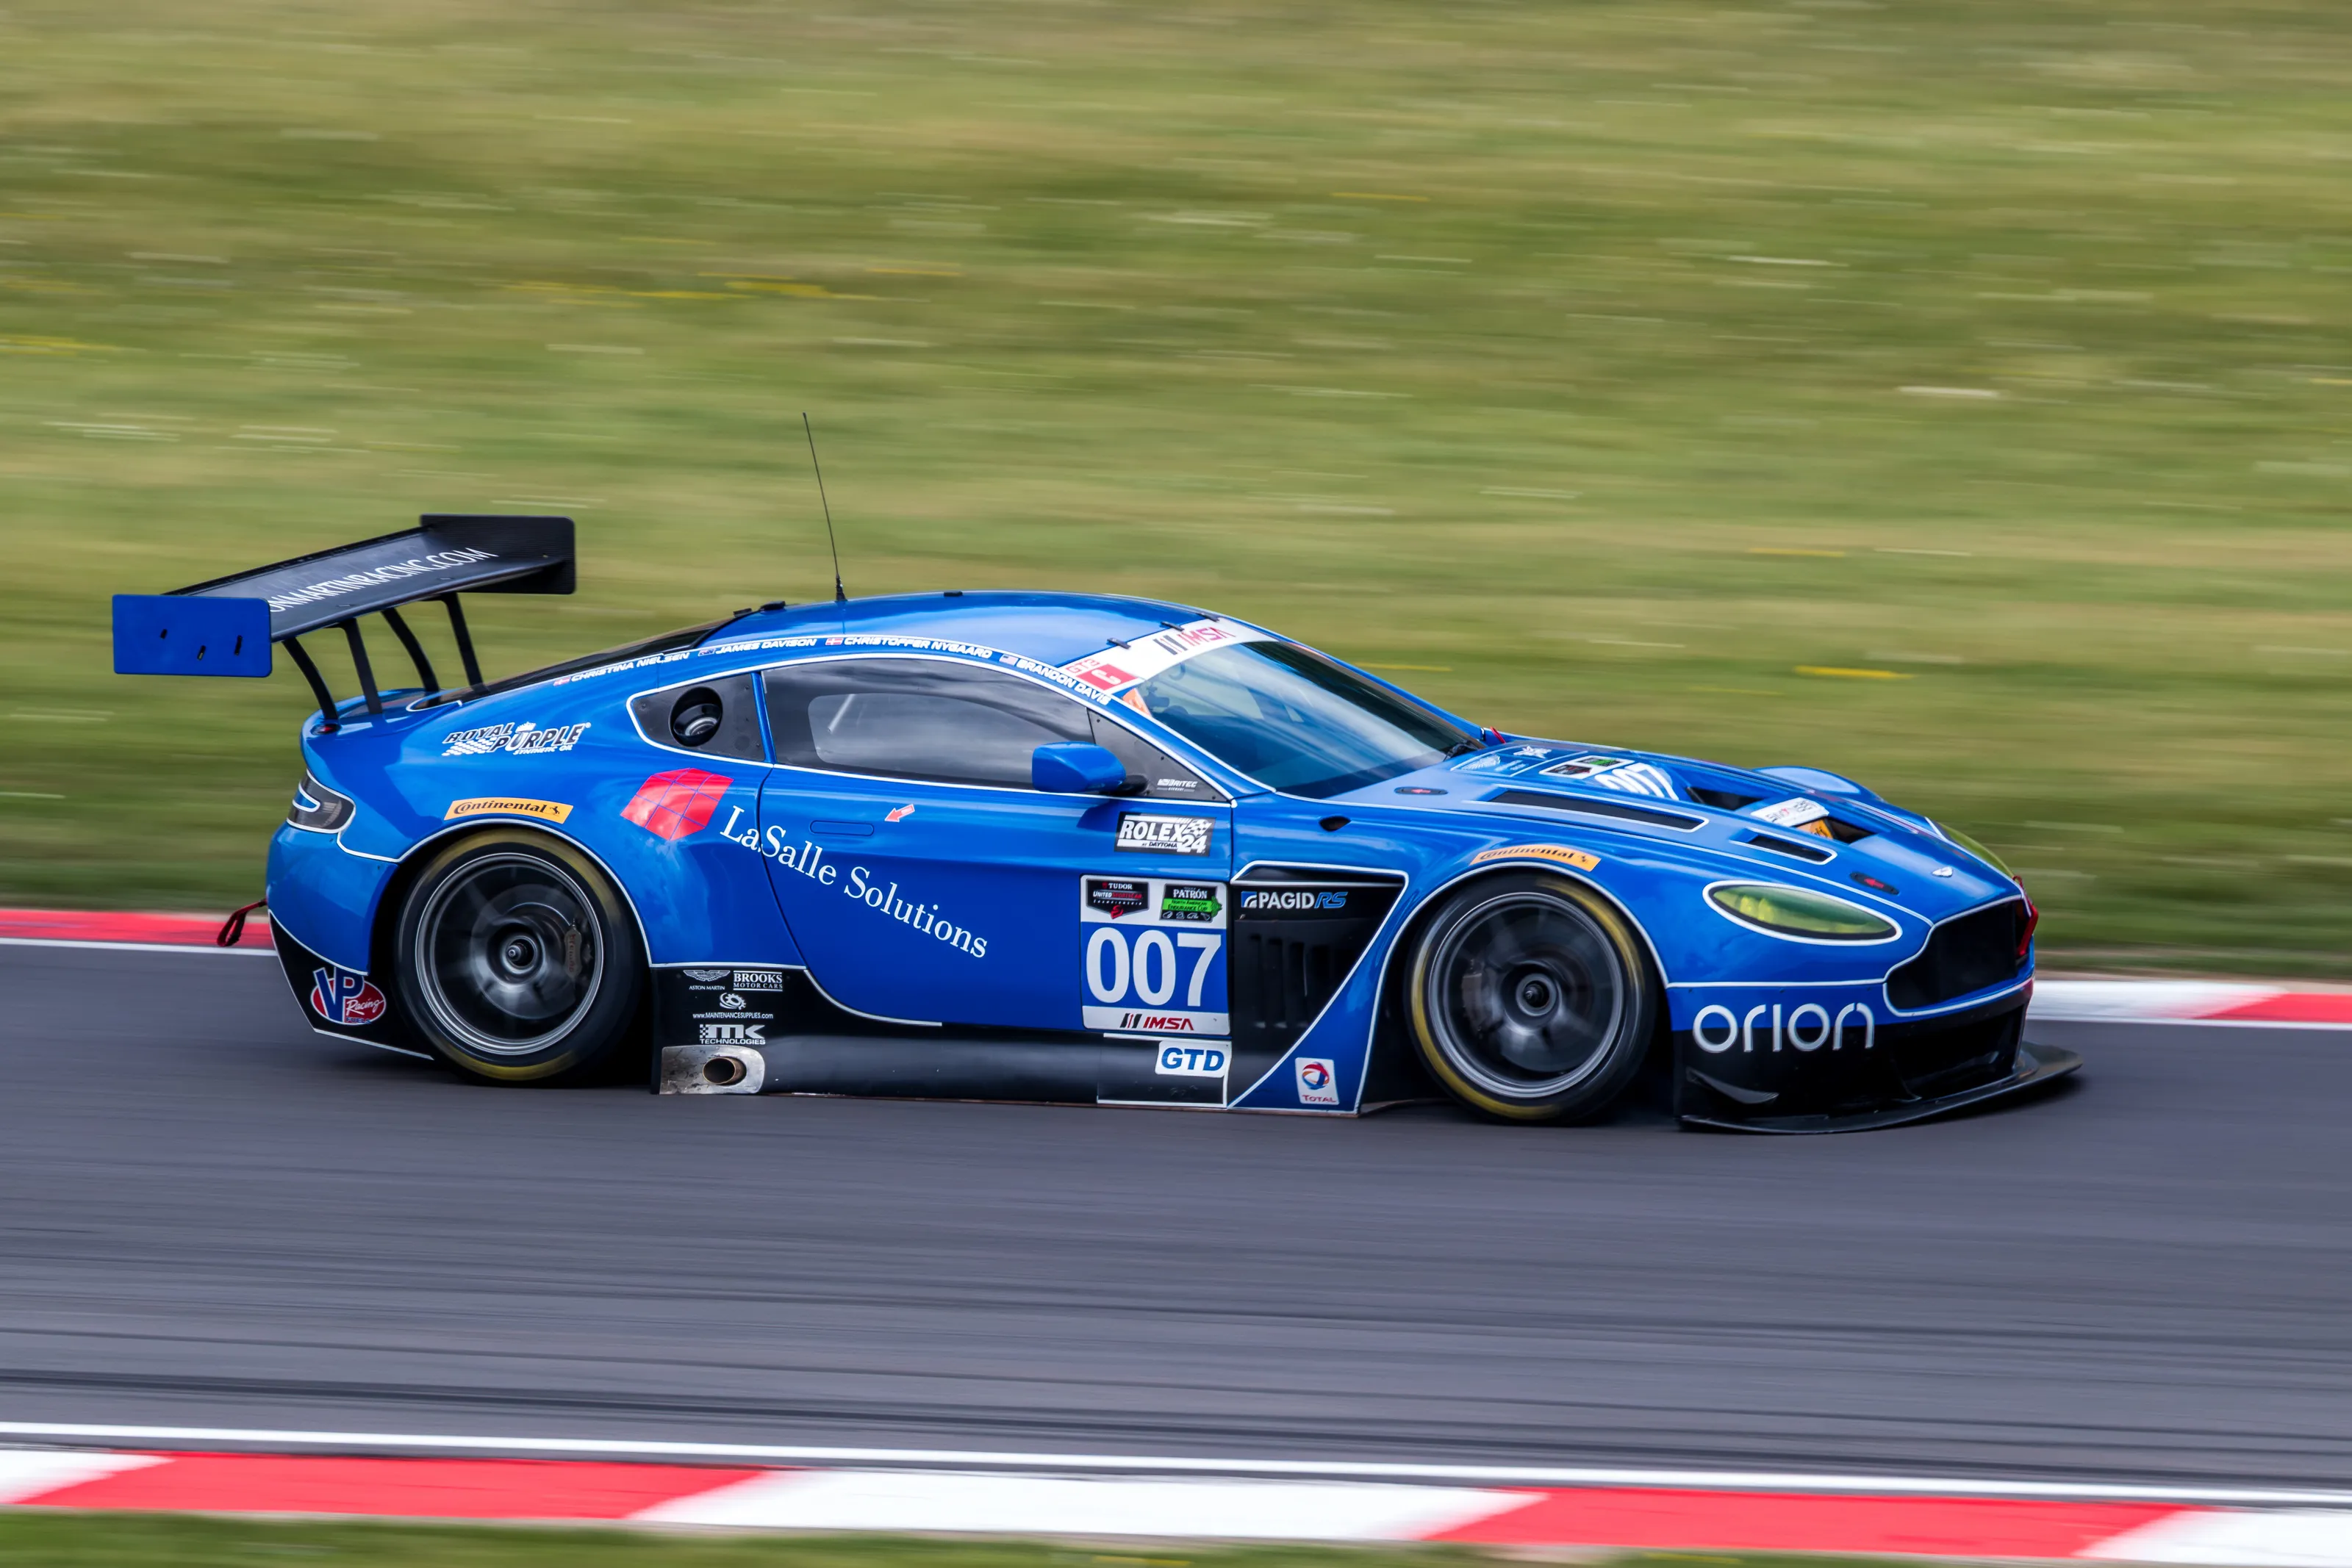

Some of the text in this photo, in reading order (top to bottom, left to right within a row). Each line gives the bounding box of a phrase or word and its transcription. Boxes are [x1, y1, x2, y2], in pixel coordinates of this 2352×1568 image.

[1177, 627, 1236, 647] IMSA
[570, 637, 1112, 705] CHRISTINA NIELSEN JAMES DAVISON CHRISTOFFER NYGAARD BRANDON DAVIS
[442, 722, 514, 744] ROYAL
[486, 722, 586, 753] PURPLE
[1594, 762, 1679, 801] 007
[453, 800, 548, 815] Continental
[1119, 821, 1208, 854] ROLEX 24
[1480, 846, 1576, 860] Continental
[720, 805, 988, 958] LaSalle Solutions
[1173, 888, 1208, 899] PATRÓN
[1258, 891, 1348, 909] PAGID RS
[1086, 927, 1222, 1007] 007
[734, 973, 783, 983] BROOKS
[312, 966, 365, 1024] VP
[346, 998, 381, 1016] Racing
[1143, 1016, 1194, 1030] IMSA
[1161, 1047, 1225, 1071] GTD
[1302, 1094, 1336, 1103] TOTAL
